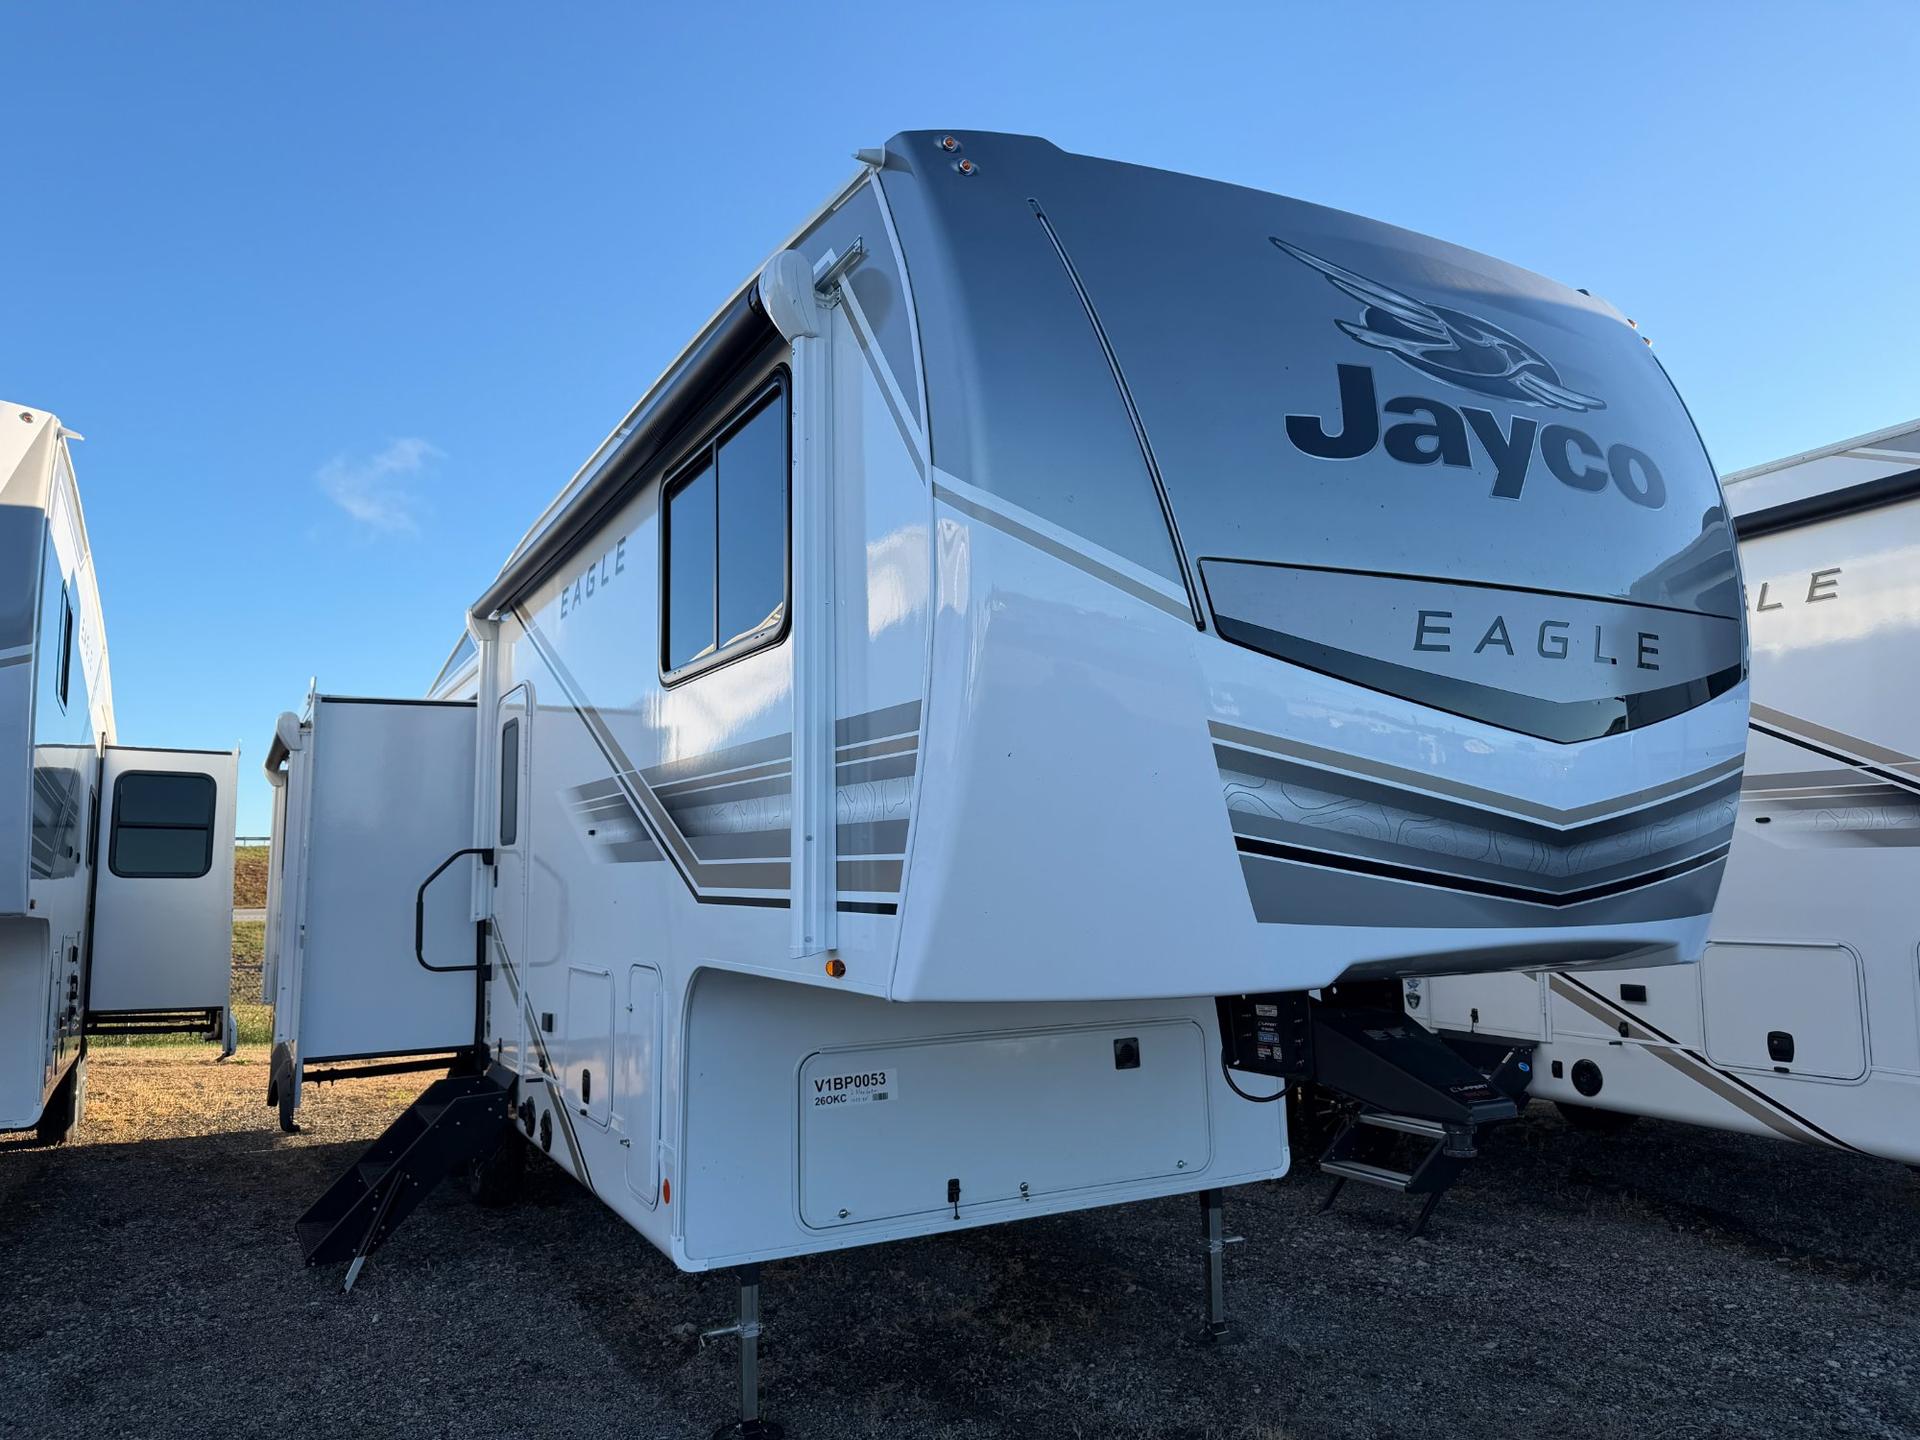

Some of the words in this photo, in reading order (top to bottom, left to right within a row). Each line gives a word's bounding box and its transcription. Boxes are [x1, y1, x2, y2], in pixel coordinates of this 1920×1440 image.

[1284, 363, 1666, 509] Jayco
[560, 535, 626, 619] EAGLE
[1743, 567, 1842, 612] LE
[1412, 610, 1660, 671] EAGLE
[814, 1072, 886, 1092] V1BP0053
